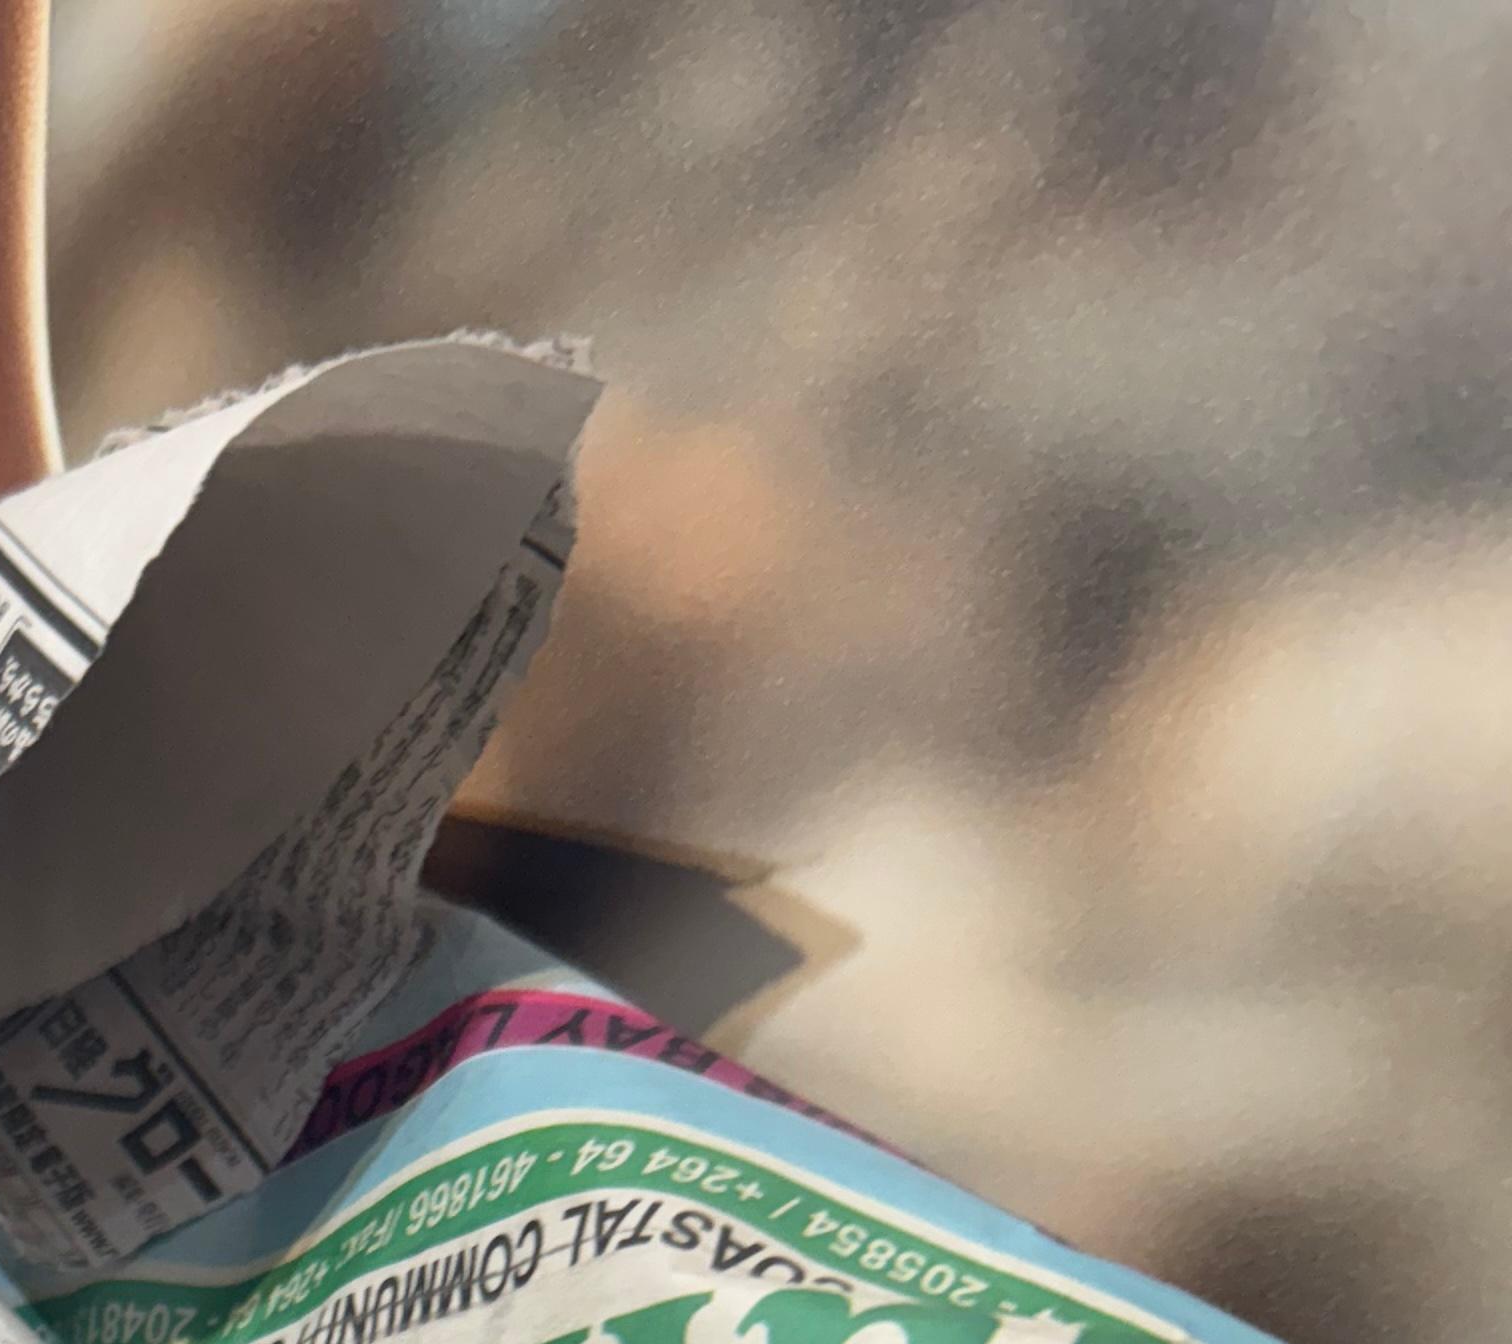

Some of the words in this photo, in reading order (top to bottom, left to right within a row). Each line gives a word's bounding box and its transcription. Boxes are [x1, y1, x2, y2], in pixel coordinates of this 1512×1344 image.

[397, 1149, 544, 1234] 461866
[574, 1137, 632, 1166] 64
[642, 1143, 766, 1204] +264
[564, 1197, 855, 1286] OASTAL
[801, 1207, 988, 1310] 205854
